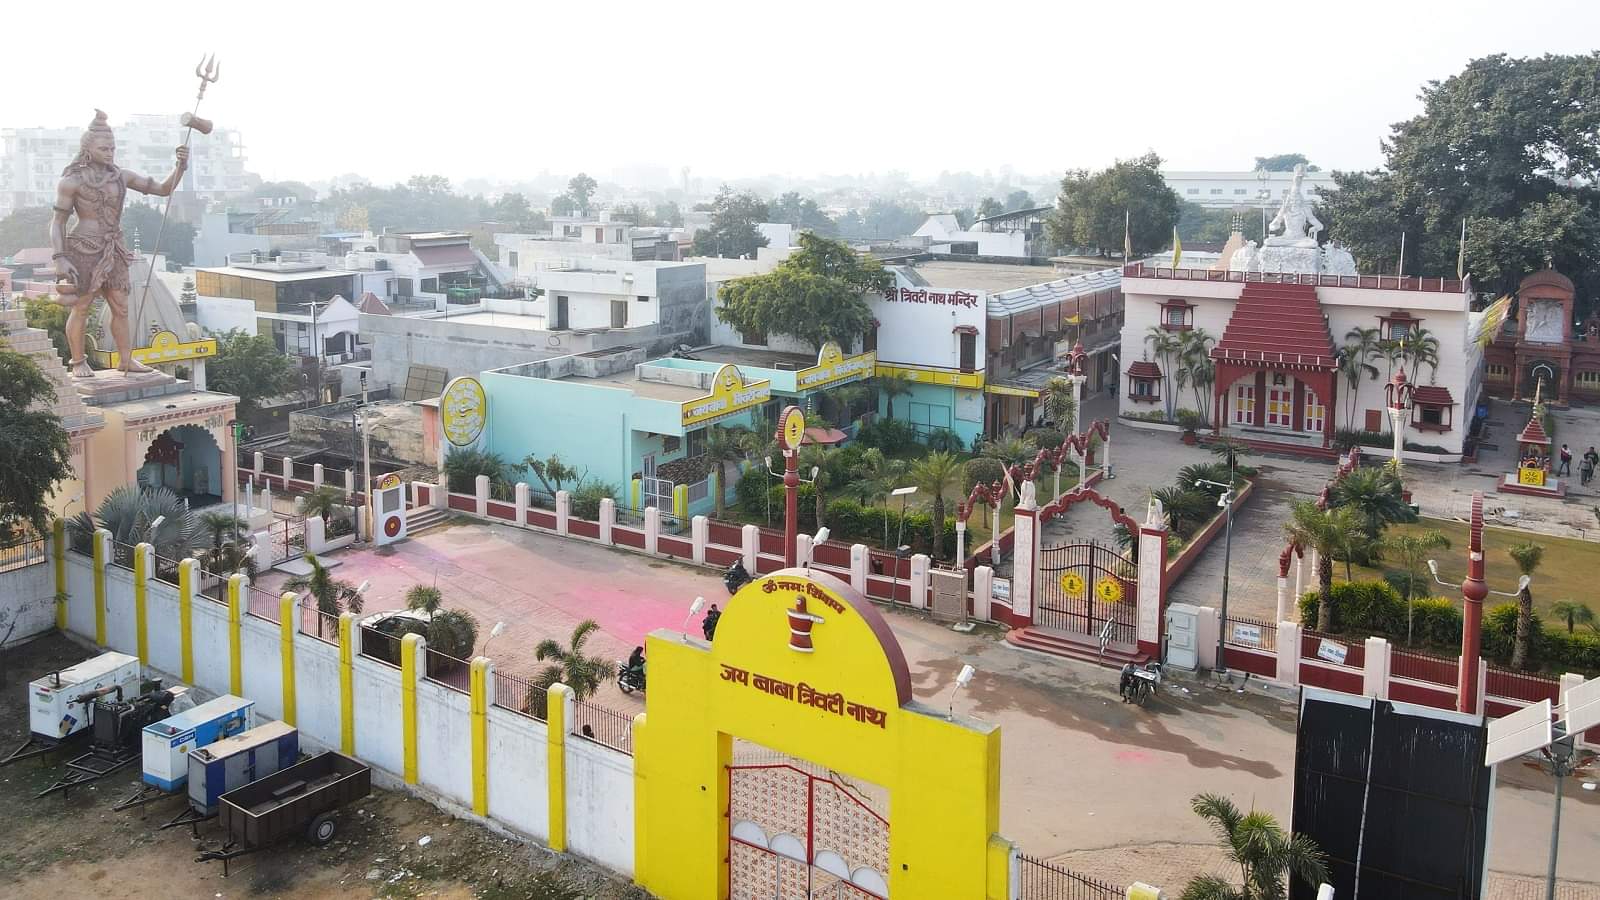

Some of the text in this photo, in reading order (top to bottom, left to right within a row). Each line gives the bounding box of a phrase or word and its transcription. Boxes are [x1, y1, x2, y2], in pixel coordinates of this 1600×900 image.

[885, 287, 898, 303] श्री
[901, 288, 928, 305] त्रिवटी
[928, 292, 946, 305] नाथ
[762, 579, 846, 614] ॐ नमः शिवाय
[720, 663, 888, 729] जय बाबा त्रिवटी नाथ
